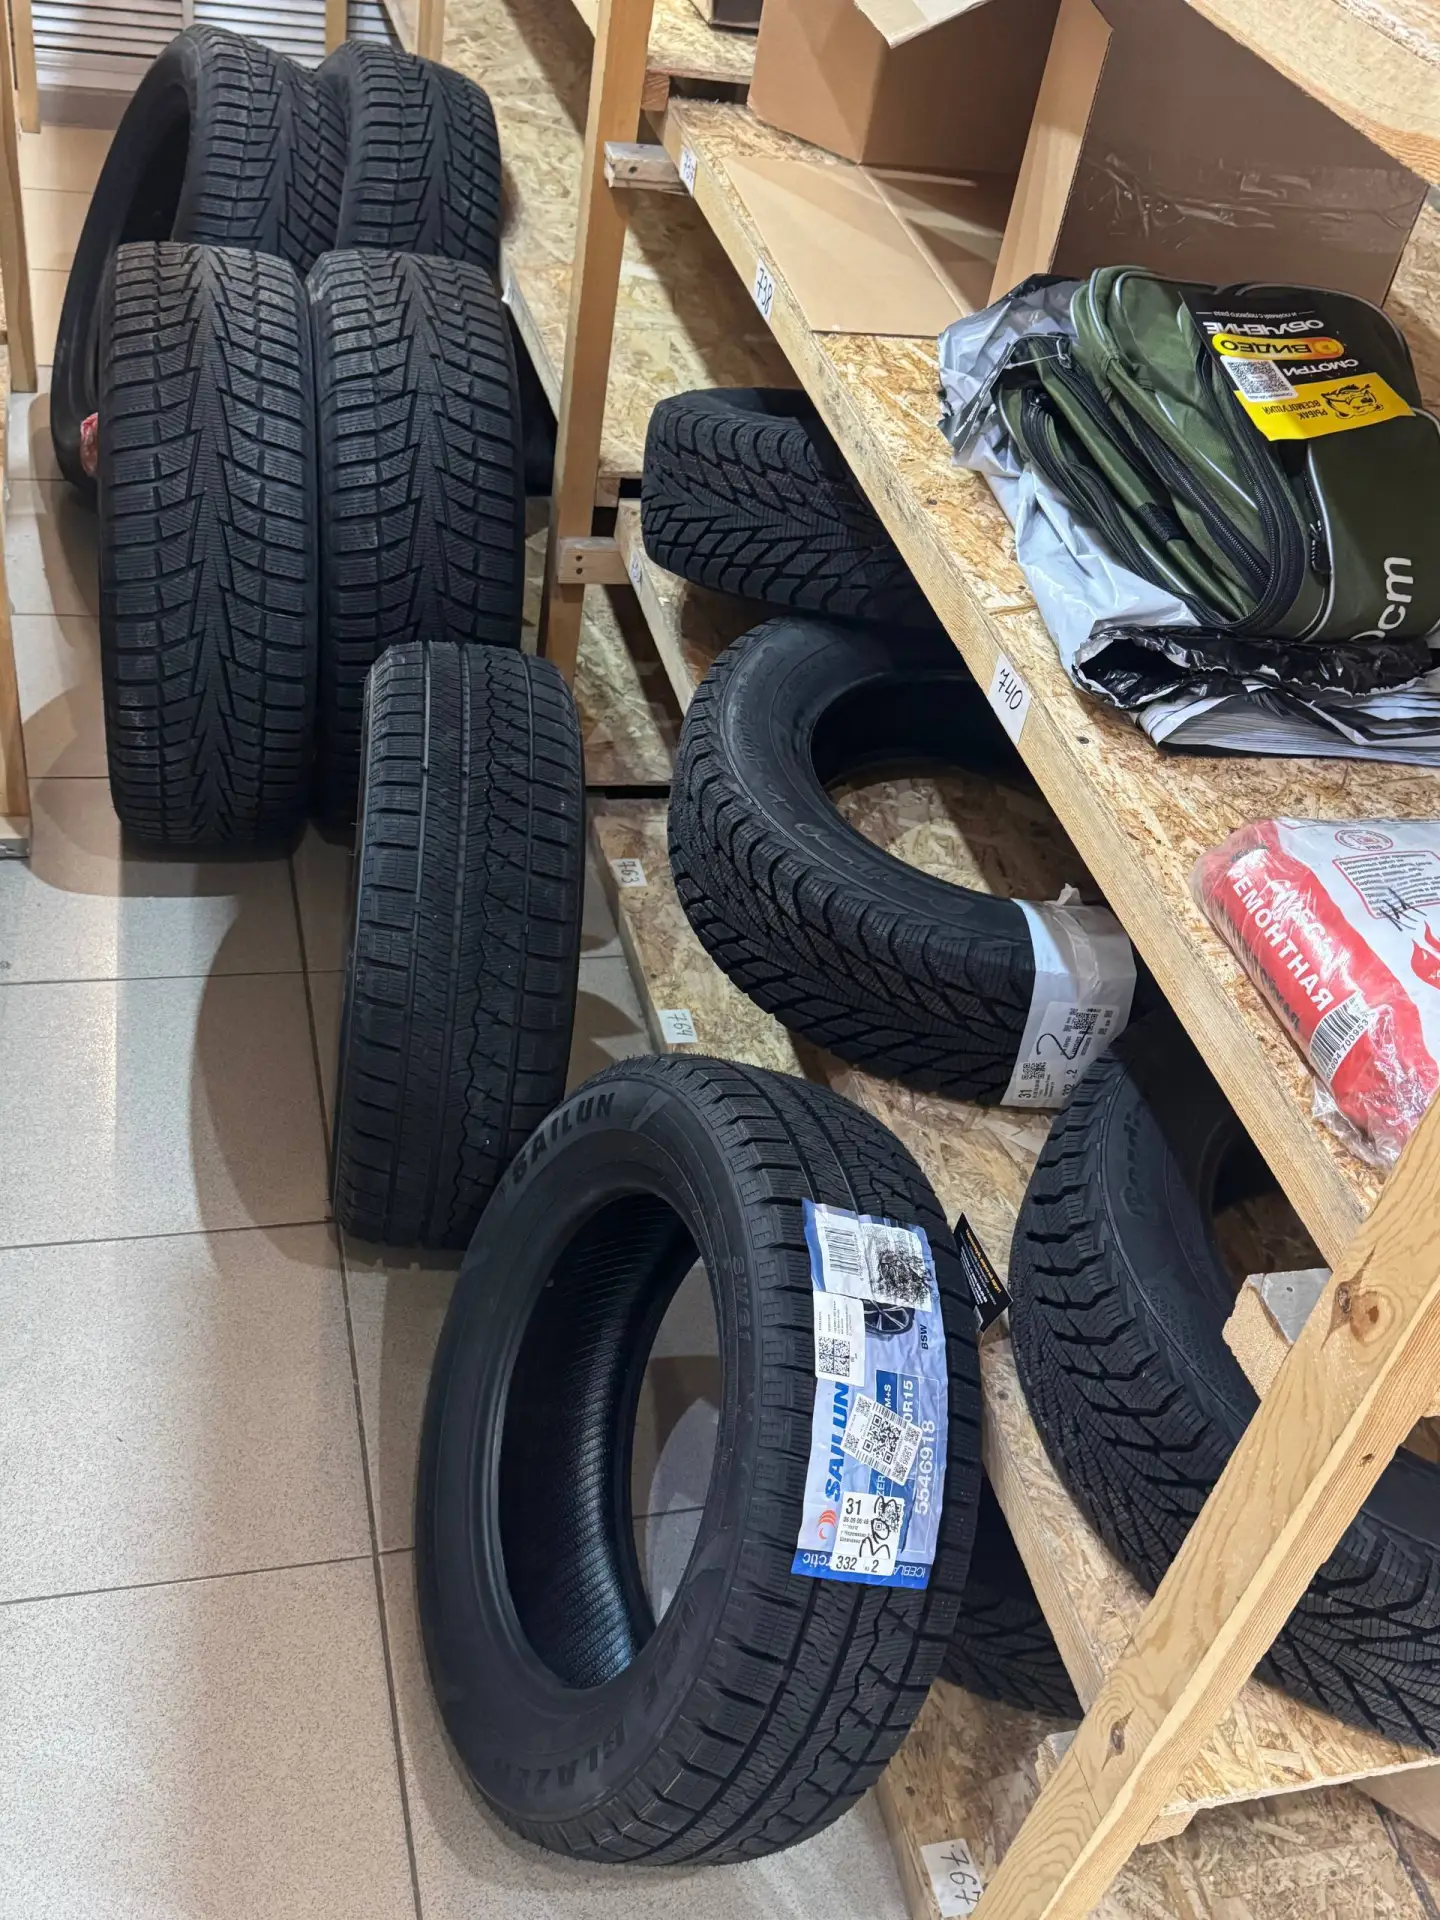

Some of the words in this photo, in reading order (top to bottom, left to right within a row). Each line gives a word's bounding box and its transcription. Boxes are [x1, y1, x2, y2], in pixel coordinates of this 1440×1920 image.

[757, 267, 773, 315] 738
[1202, 319, 1325, 336] ОБУЧЕНИЕ
[1220, 339, 1312, 354] ВИДЕО
[1283, 358, 1359, 377] СМОТРИ
[1262, 399, 1321, 415] ВСЕМОГУЩИЙ
[1299, 406, 1328, 419] РЫБАК
[998, 668, 1023, 710] 740
[617, 861, 640, 883] 763
[667, 1013, 693, 1037] 764
[1341, 1019, 1368, 1051] 700953
[1018, 1089, 1032, 1099] 31
[510, 1091, 617, 1184] SAILUN
[920, 1324, 929, 1350] BSW
[884, 1384, 892, 1408] M+S
[825, 1382, 849, 1502] SAILUN
[915, 1420, 936, 1516] 5546918
[845, 1497, 861, 1515] 31
[836, 1556, 858, 1571] 332
[870, 1559, 879, 1573] 2
[940, 1848, 981, 1906] 767
